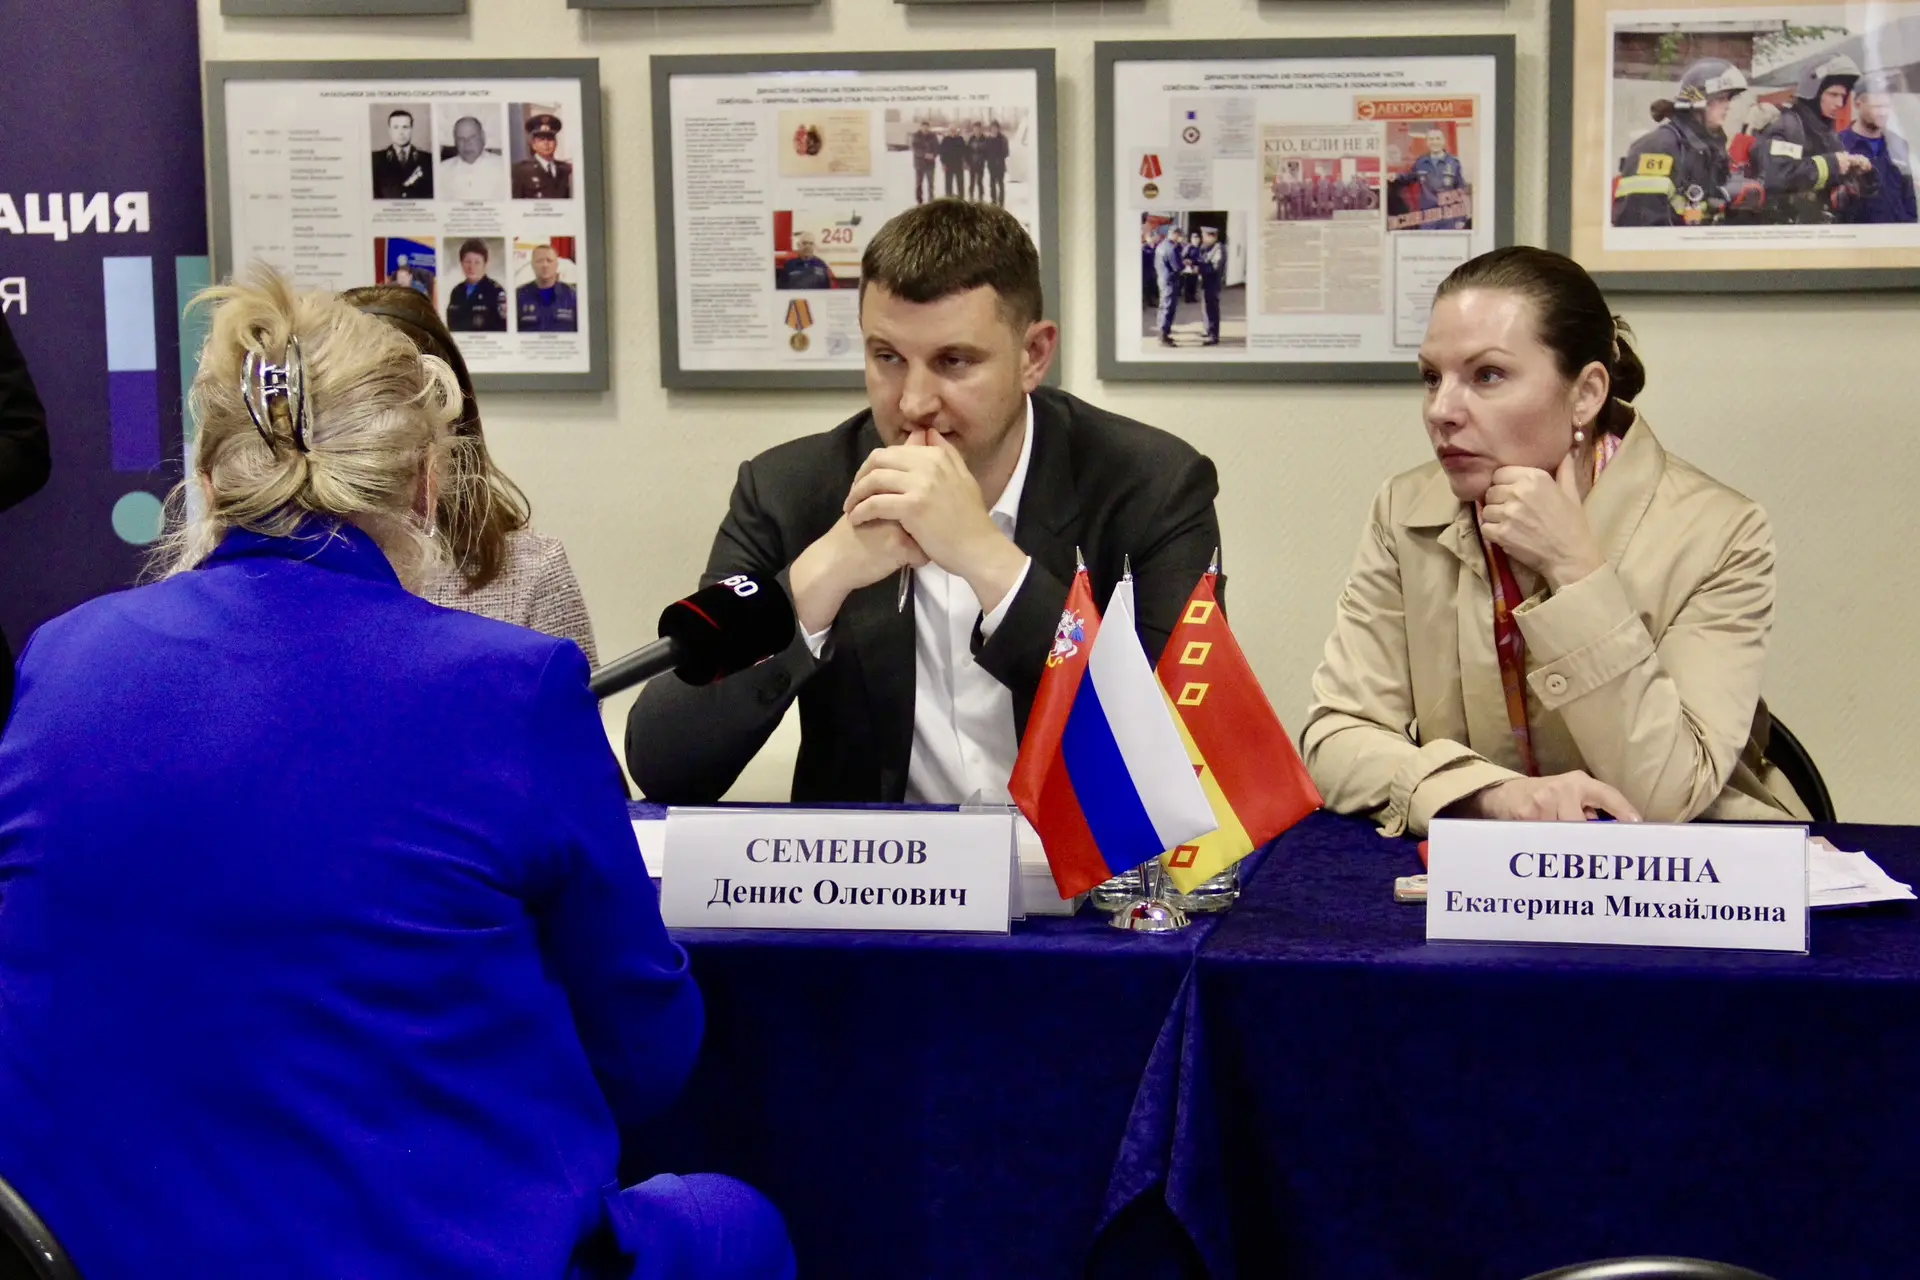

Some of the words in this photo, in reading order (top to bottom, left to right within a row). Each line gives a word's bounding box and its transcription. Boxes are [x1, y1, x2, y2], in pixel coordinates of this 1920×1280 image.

[1301, 139, 1338, 152] ЕСЛИ
[1344, 138, 1361, 151] НЕ
[0, 191, 150, 241] АЦИЯ
[821, 228, 853, 244] 240
[717, 575, 759, 598] 60
[746, 838, 928, 865] СЕМЕНОВ
[1508, 851, 1722, 884] СЕВЕРИНА
[707, 877, 803, 910] Денис
[812, 879, 968, 906] Олегович
[1444, 889, 1595, 921] Екатерина
[1604, 894, 1787, 923] Михайловна
